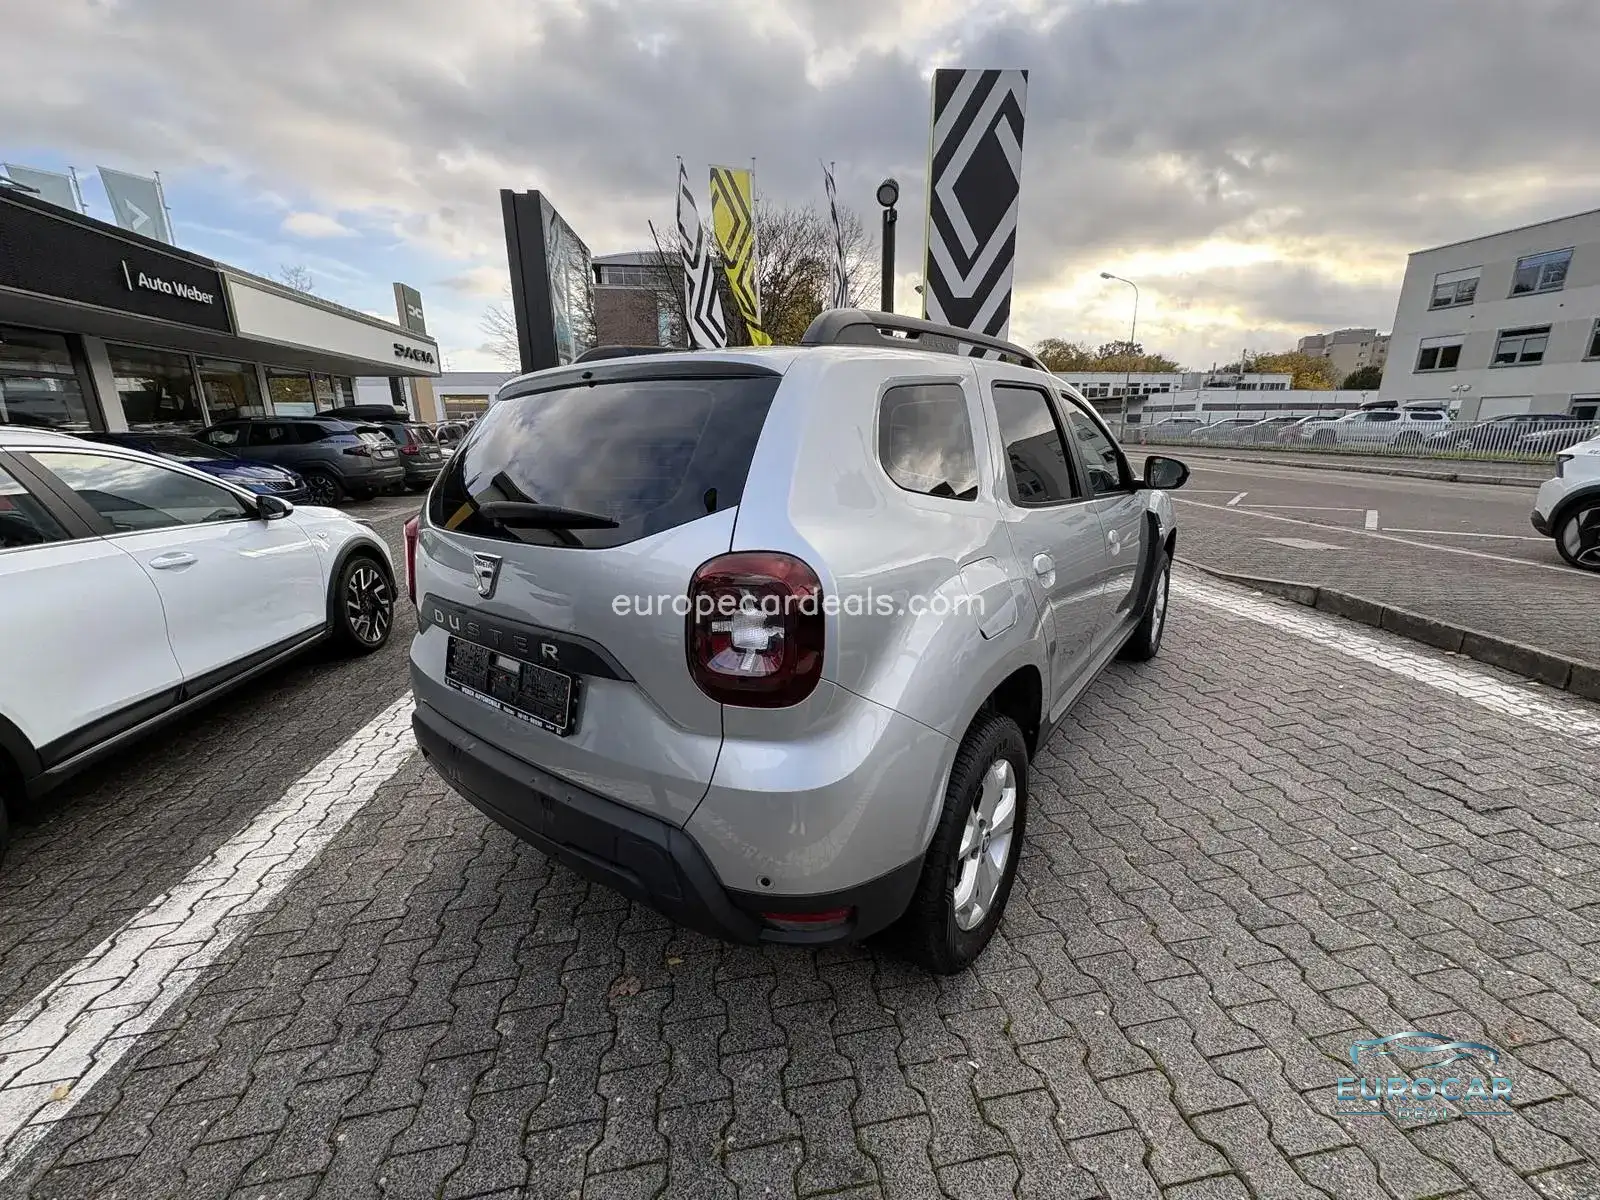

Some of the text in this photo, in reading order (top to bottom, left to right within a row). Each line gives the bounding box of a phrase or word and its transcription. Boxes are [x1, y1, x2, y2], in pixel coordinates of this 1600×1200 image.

[138, 272, 214, 305] Auto Weber
[433, 609, 559, 661] DUSTER
